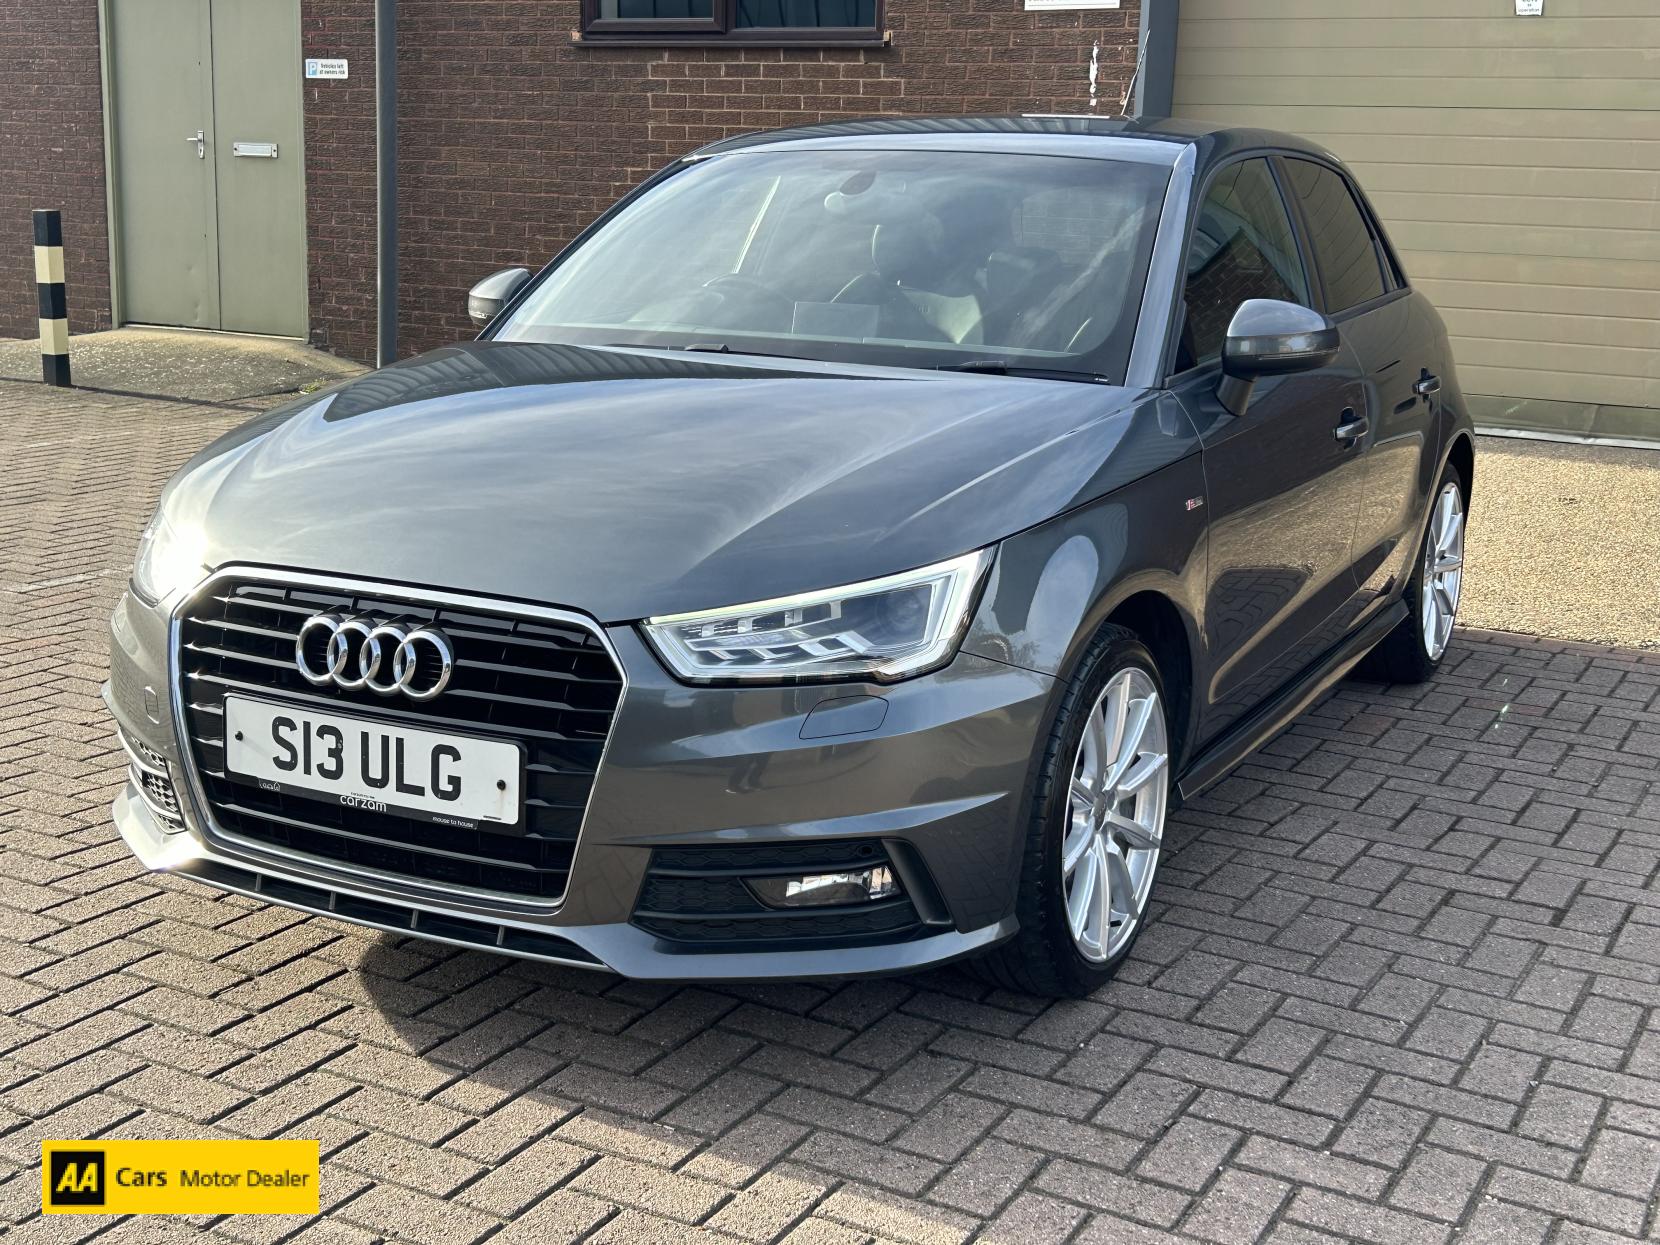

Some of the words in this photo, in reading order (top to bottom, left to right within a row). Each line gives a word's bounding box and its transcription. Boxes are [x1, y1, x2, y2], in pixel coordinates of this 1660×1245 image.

[309, 62, 317, 75] P
[360, 730, 462, 802] ULG
[339, 794, 387, 813] carzam
